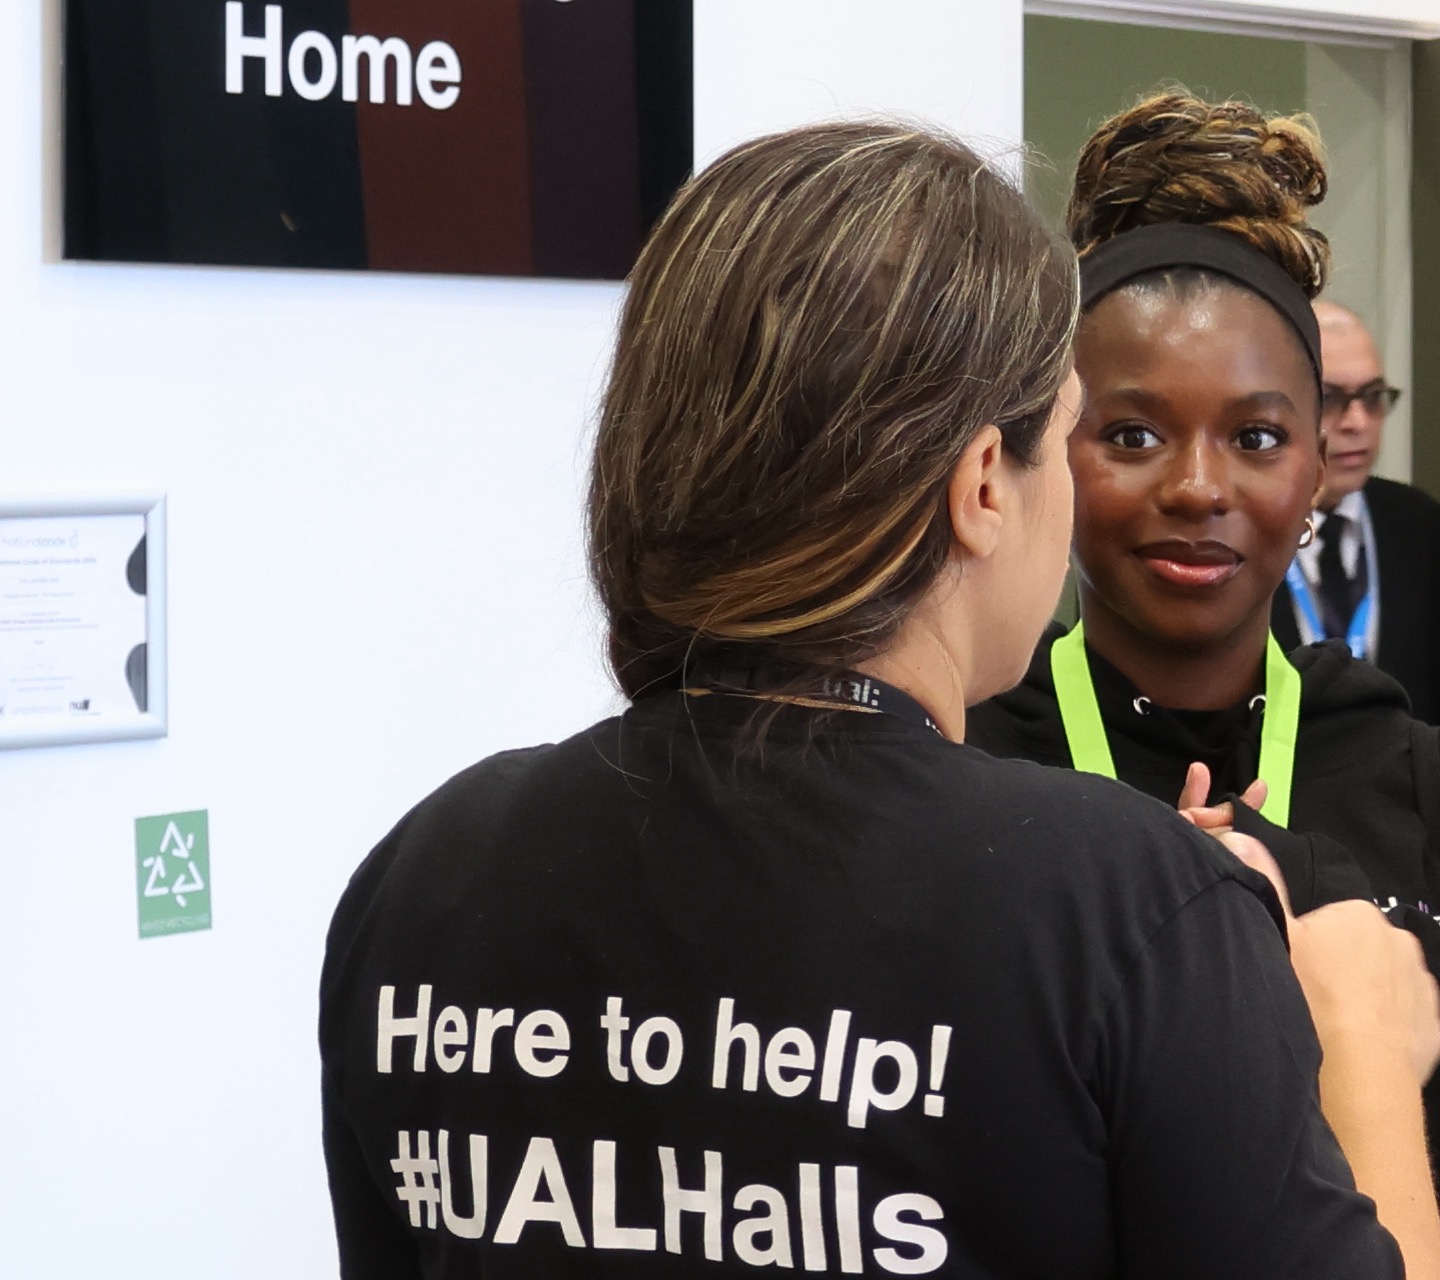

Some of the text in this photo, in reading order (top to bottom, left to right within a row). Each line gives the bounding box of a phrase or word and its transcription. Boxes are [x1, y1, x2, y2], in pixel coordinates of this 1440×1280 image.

[224, 1, 462, 110] Home
[376, 984, 953, 1129] Here to help!
[390, 1128, 949, 1276] #UALHalls
